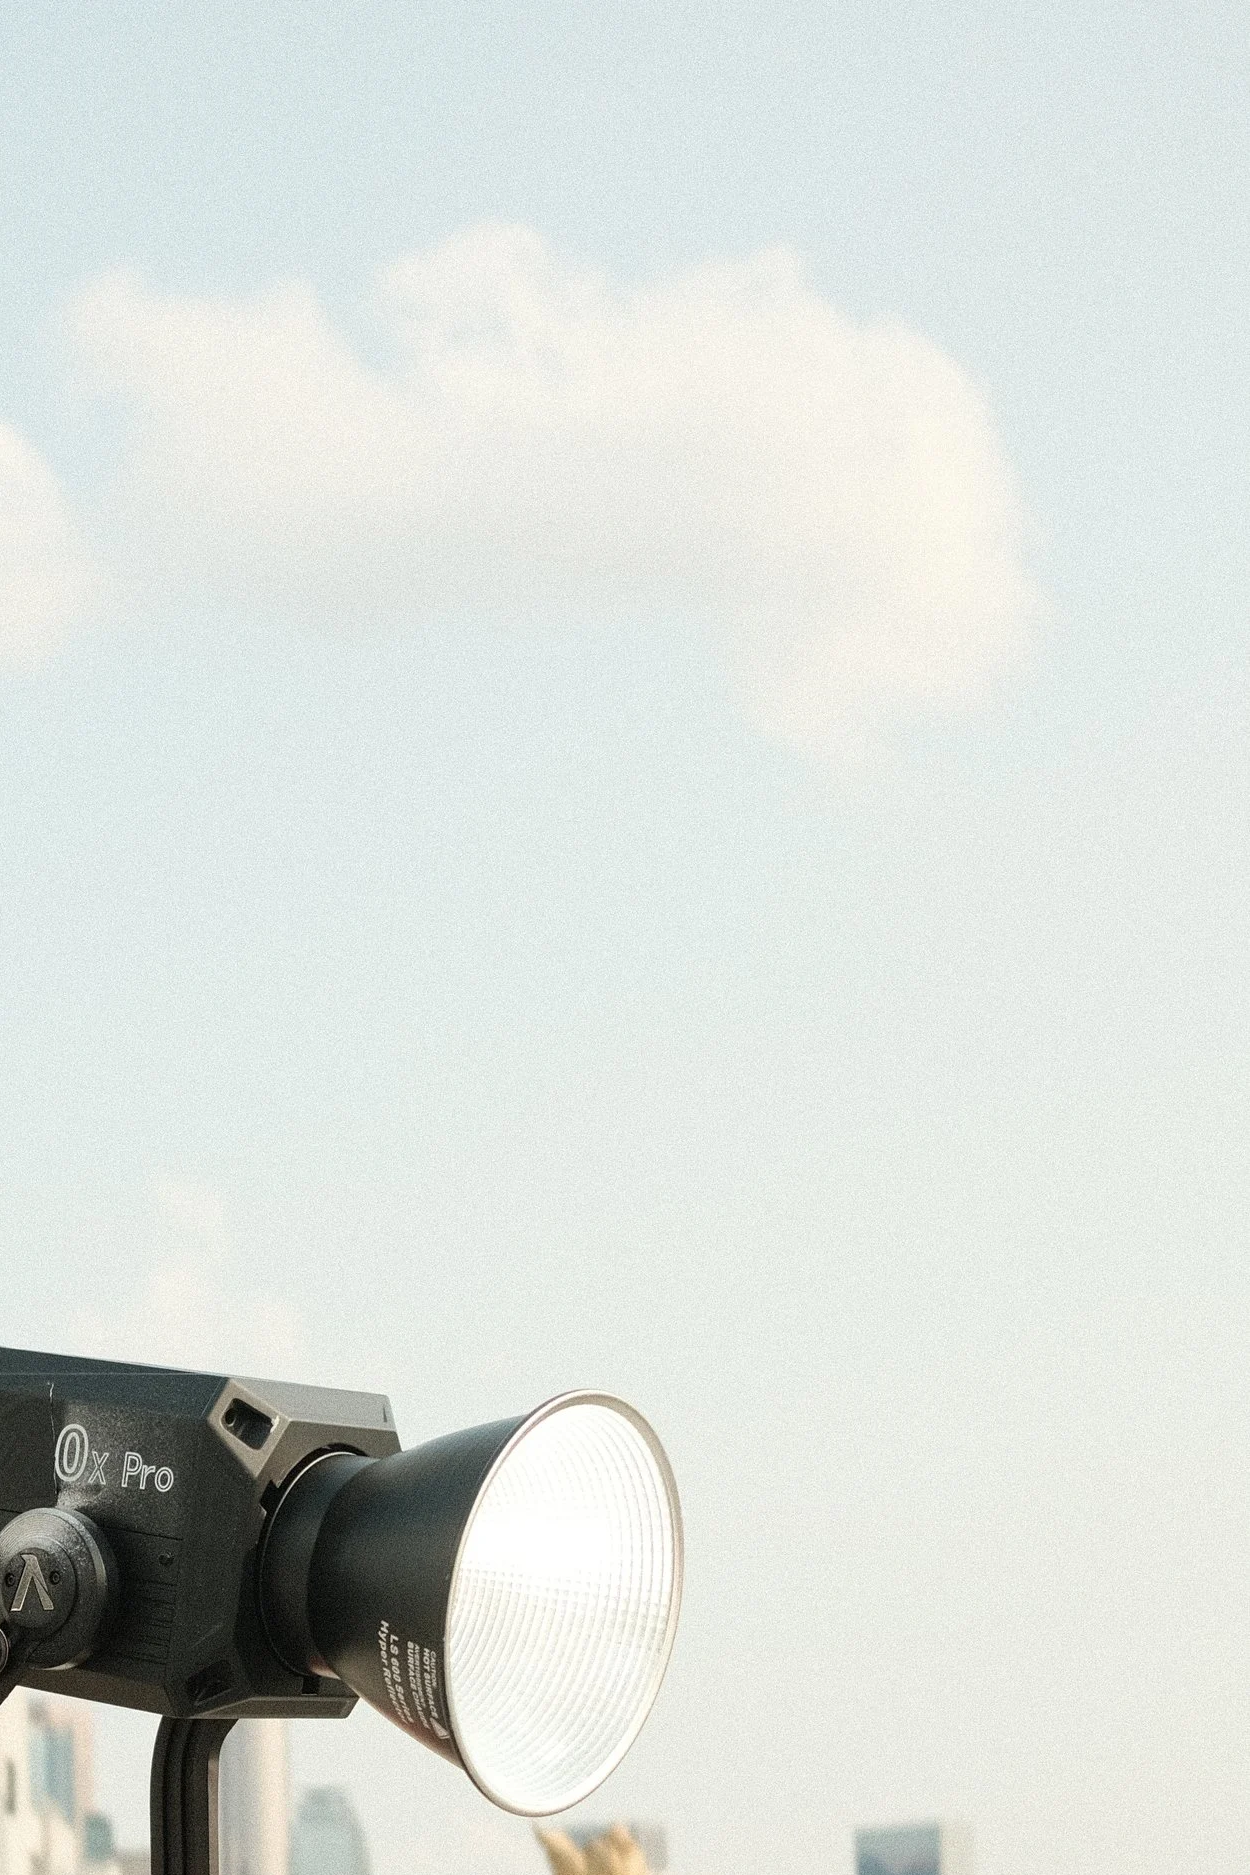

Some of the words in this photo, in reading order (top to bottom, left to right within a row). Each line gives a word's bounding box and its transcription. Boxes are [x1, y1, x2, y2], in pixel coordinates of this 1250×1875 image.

[122, 1452, 175, 1493] Pro
[378, 1620, 389, 1666] Hyper
[390, 1634, 399, 1655] LS
[423, 1648, 431, 1671] HOT
[391, 1658, 401, 1682] 600
[407, 1641, 417, 1690] SURFACE
[383, 1668, 409, 1724] Reflector
[395, 1684, 414, 1723] Series
[424, 1672, 438, 1718] SURFACE
